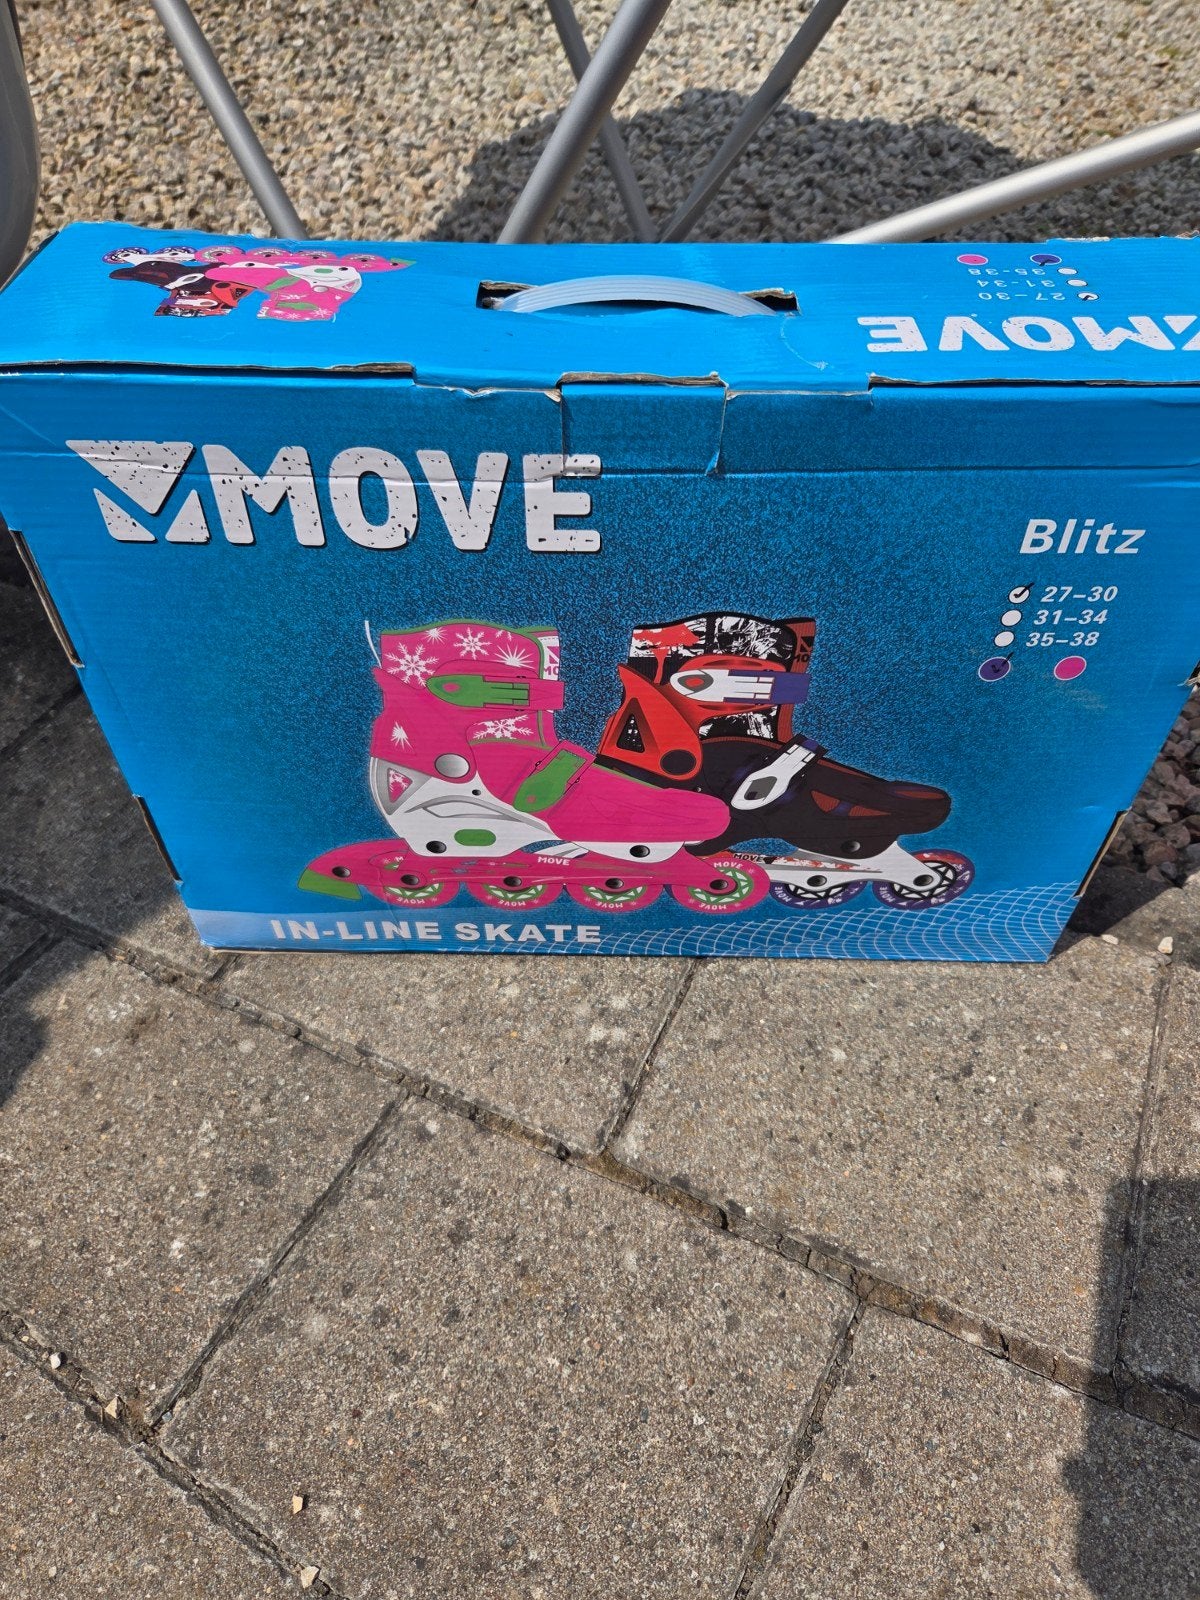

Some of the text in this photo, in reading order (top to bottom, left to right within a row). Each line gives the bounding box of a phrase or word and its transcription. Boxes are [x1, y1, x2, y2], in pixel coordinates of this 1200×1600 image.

[968, 267, 1046, 276] 35-38
[976, 279, 1056, 288] 31-34
[977, 291, 1066, 301] 27-30
[857, 316, 1176, 352] MOVE
[202, 444, 602, 552] MOVE
[1019, 518, 1147, 554] Blitz
[1040, 585, 1119, 603] 27-30
[1033, 609, 1109, 625] 31-34
[1025, 631, 1100, 647] 35-38
[537, 856, 570, 867] MOVE
[732, 852, 764, 863] MOVE
[712, 860, 744, 869] MOVE
[774, 885, 792, 903] MOVE
[880, 885, 895, 903] MOVE
[396, 895, 426, 905] MOVE
[497, 898, 527, 908] MOVE
[595, 900, 624, 910] MOVE
[698, 902, 728, 911] MOVE
[270, 919, 602, 944] IN-LINE SKATE
